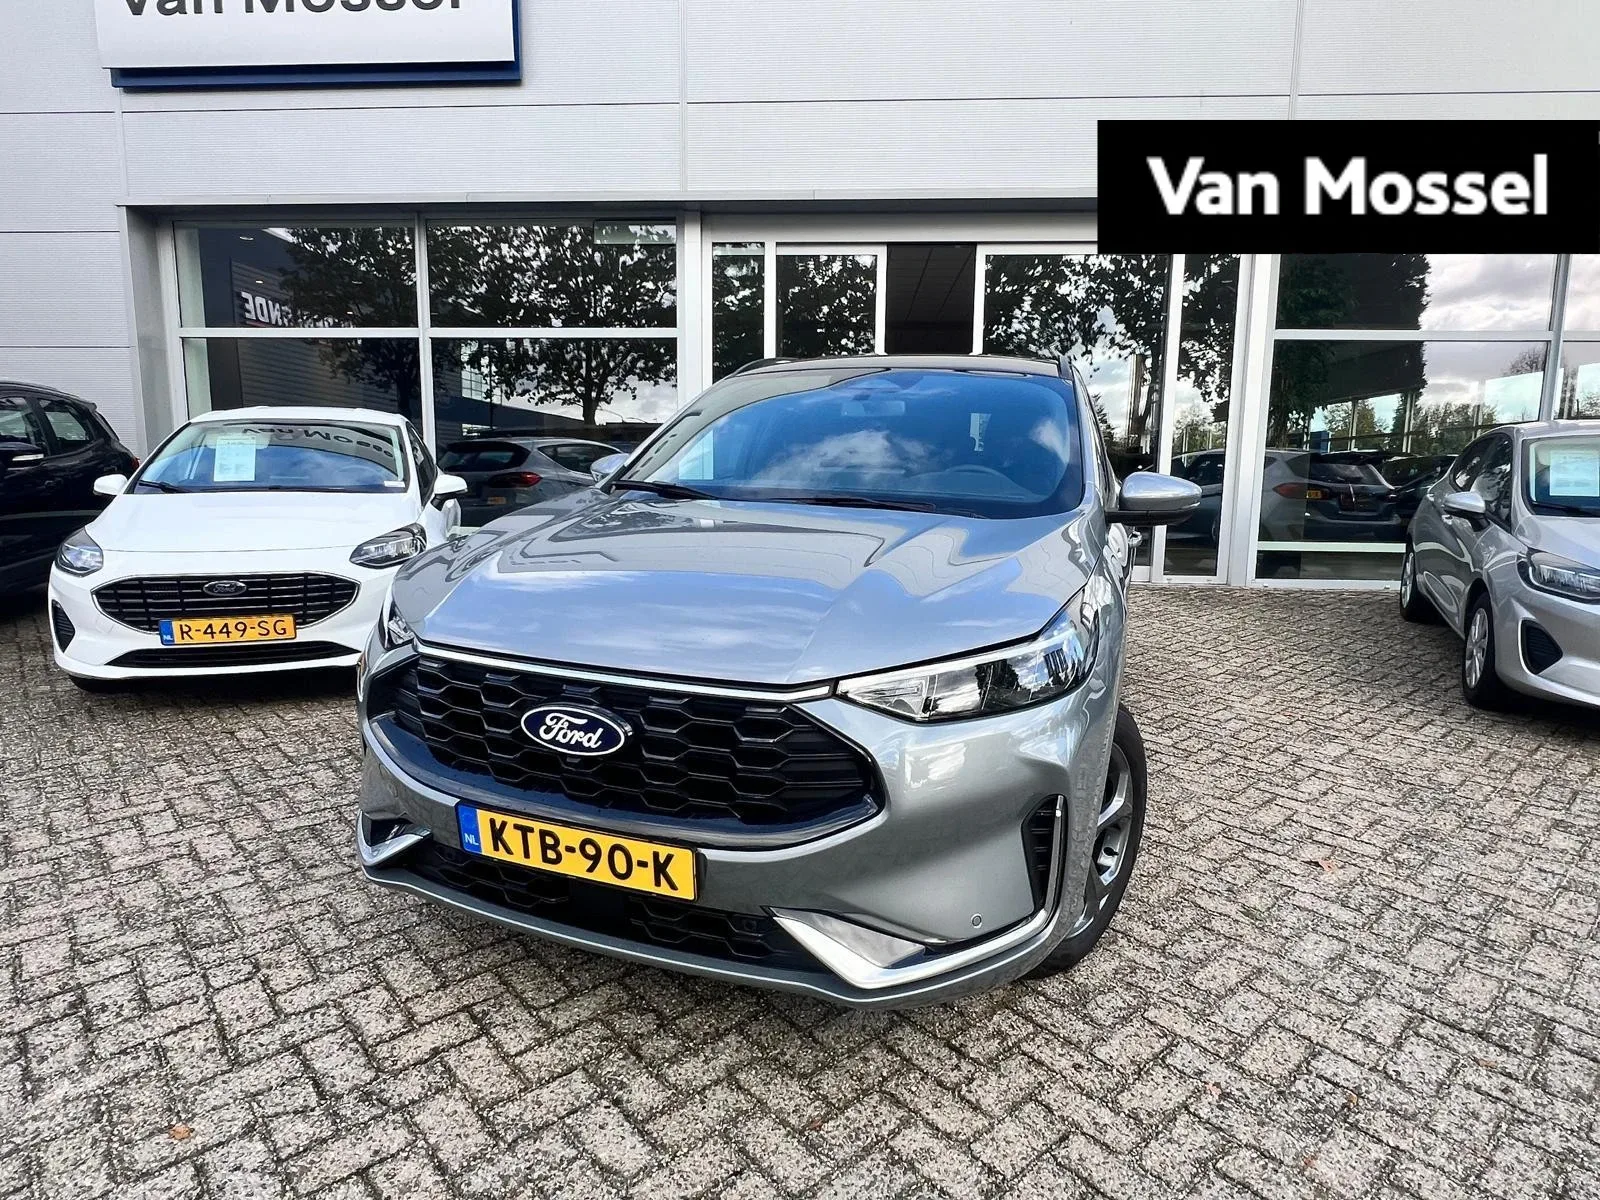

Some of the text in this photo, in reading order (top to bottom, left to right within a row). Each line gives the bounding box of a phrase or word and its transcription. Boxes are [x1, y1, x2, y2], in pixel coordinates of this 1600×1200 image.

[179, 619, 287, 641] R-449-SG
[539, 712, 603, 749] Ford
[464, 817, 679, 891] NL KTB-90-K
